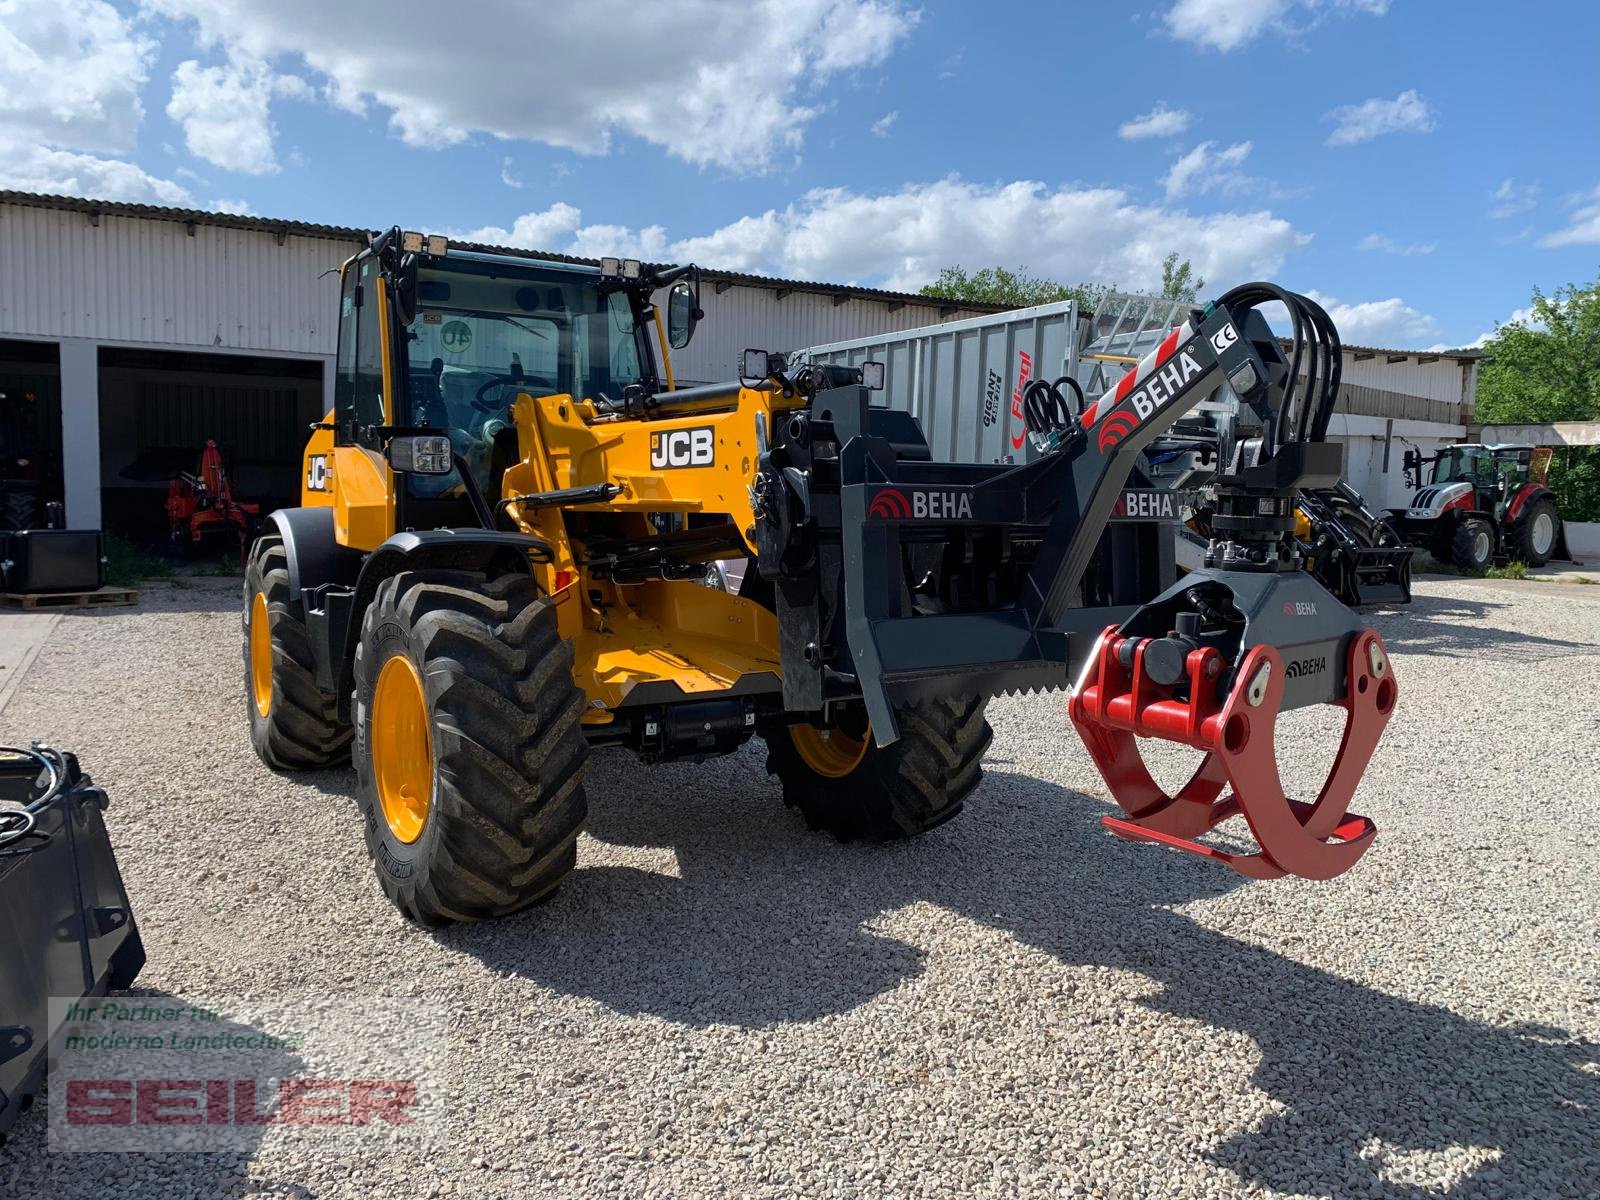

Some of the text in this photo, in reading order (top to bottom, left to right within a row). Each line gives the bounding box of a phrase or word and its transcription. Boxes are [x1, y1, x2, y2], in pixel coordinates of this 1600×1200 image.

[983, 368, 998, 428] GIGANT
[651, 428, 714, 468] JCB
[307, 456, 327, 489] JC
[912, 491, 973, 519] BEHA
[1126, 492, 1174, 517] BEHA
[1295, 602, 1318, 616] BEHA
[1302, 656, 1326, 676] BEHA
